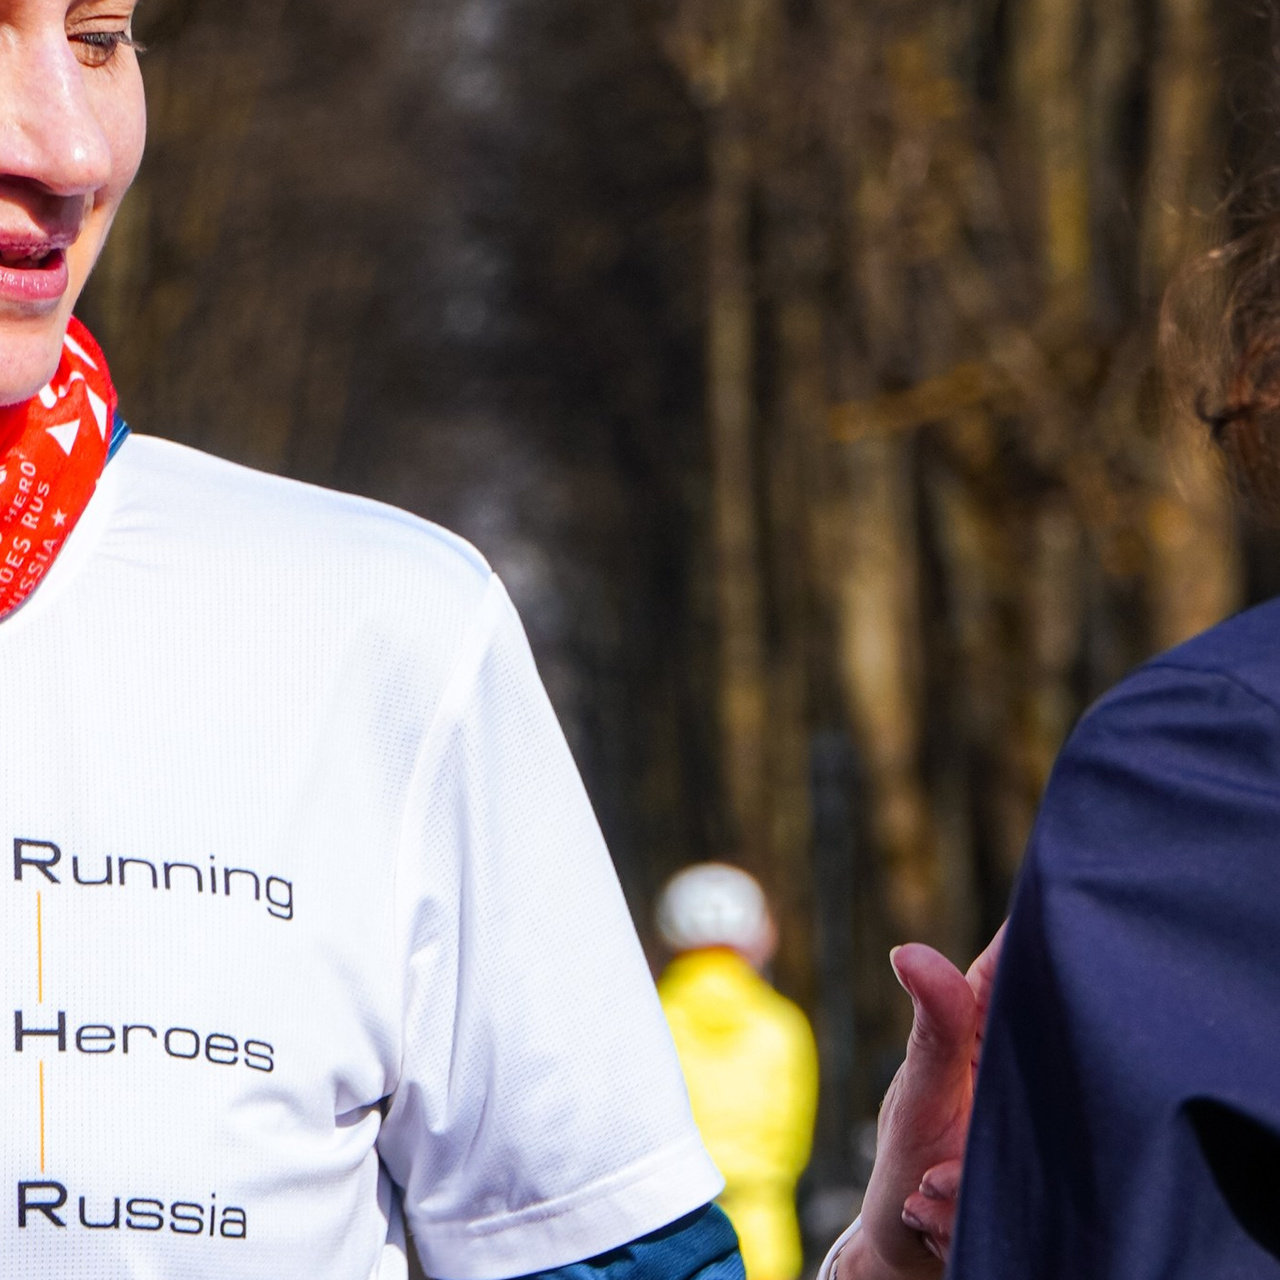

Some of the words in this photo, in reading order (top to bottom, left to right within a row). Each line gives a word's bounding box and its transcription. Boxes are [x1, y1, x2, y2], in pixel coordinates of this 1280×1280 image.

[14, 838, 293, 920] Running
[14, 1010, 275, 1072] Heroes
[18, 1181, 247, 1239] Russia
